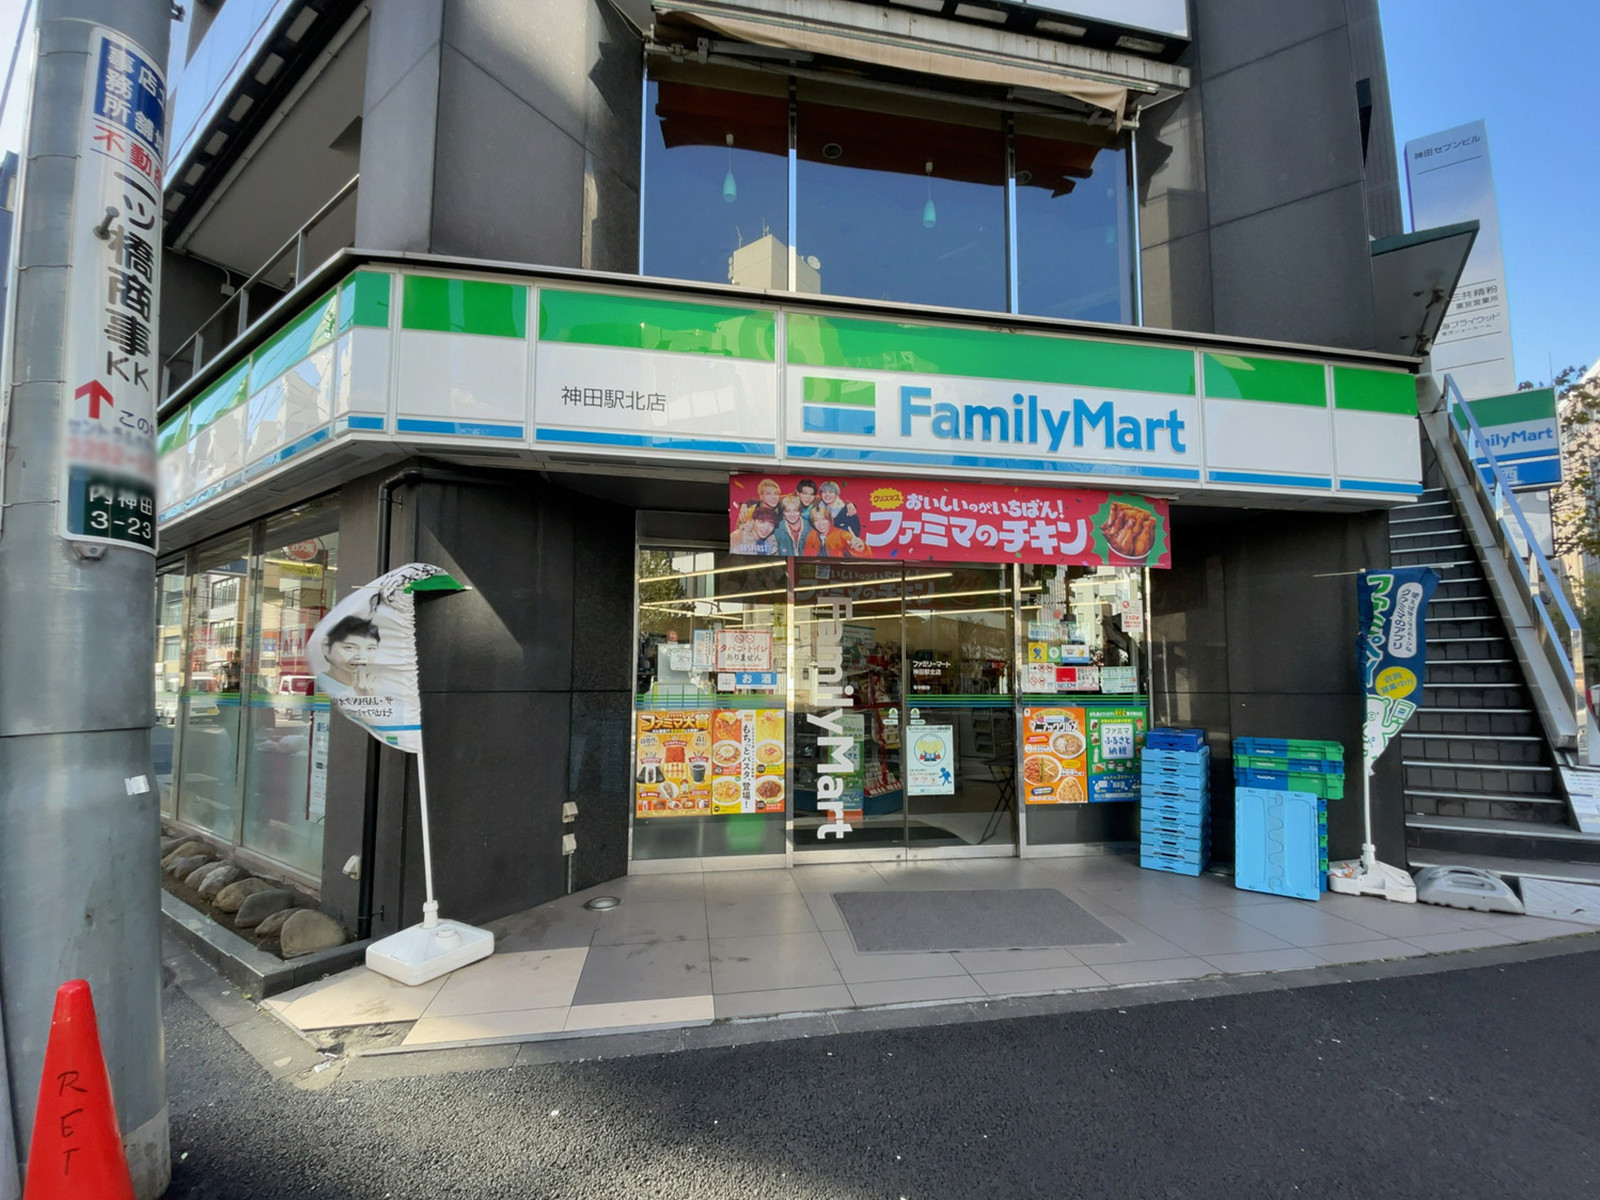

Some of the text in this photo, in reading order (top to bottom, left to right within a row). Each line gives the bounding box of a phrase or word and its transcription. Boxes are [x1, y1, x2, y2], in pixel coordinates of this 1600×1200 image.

[1414, 136, 1481, 159] 神田セブンビル
[561, 385, 666, 412] 神田駅北店
[899, 385, 1187, 454] FamilyMart
[90, 510, 152, 539] 3-23
[865, 511, 1087, 555] ファミマのチキン
[807, 596, 854, 839] FamilyMart
[1104, 736, 1131, 746] ふるさと
